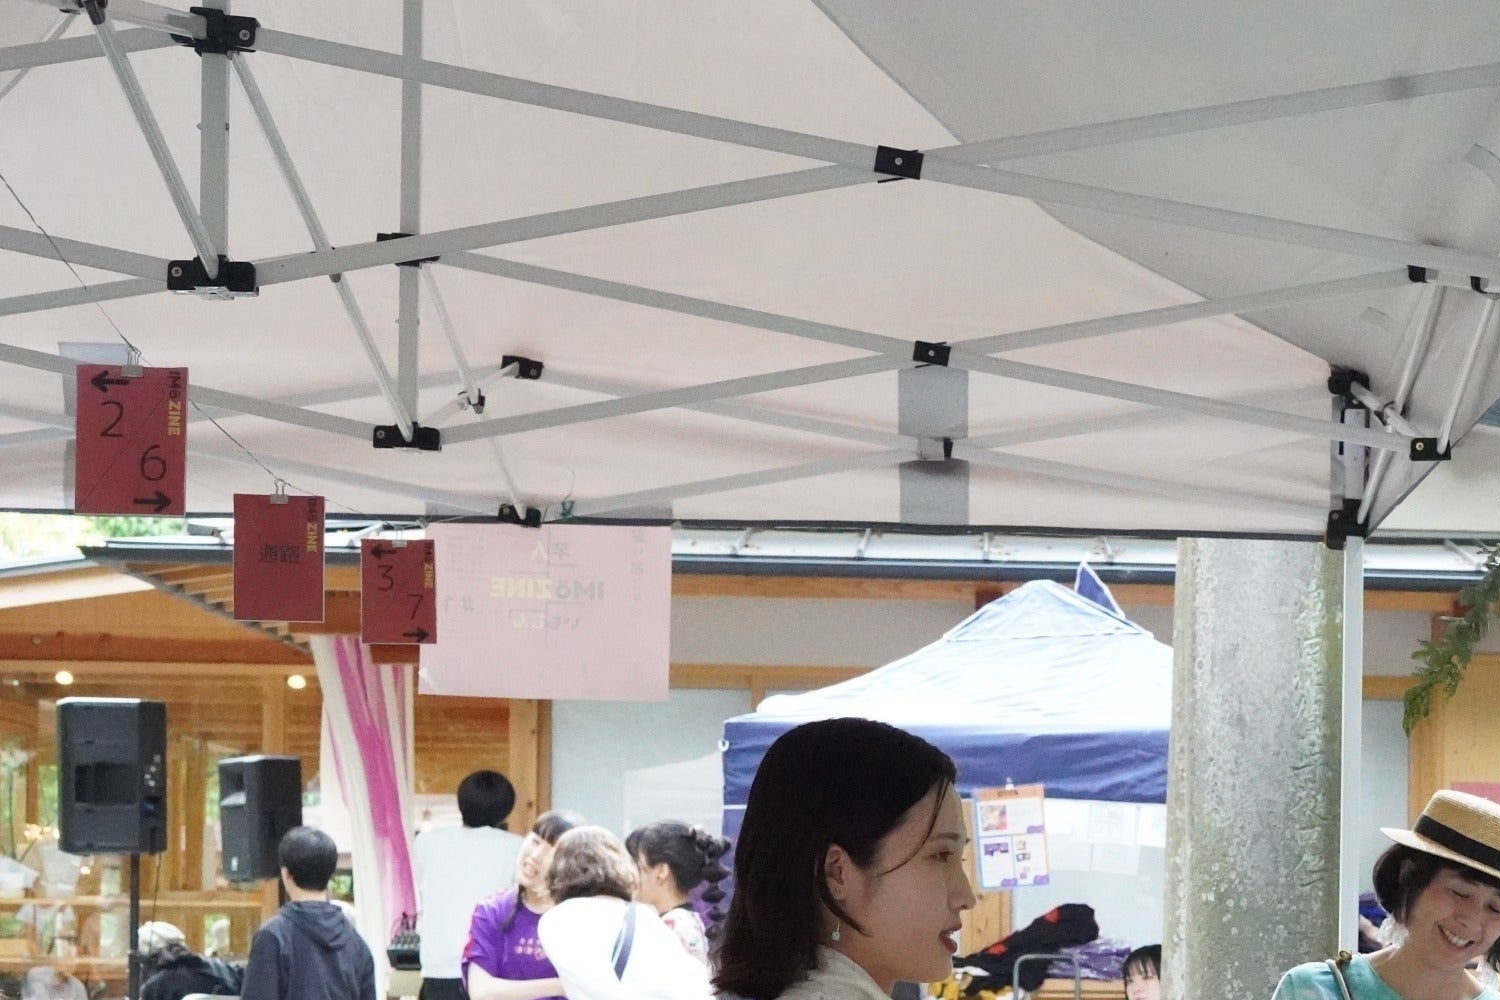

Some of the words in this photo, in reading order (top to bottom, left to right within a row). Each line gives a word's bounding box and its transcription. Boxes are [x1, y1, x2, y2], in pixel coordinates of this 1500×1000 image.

[100, 400, 124, 438] 2
[140, 444, 167, 482] 6
[377, 565, 395, 592] 3
[406, 594, 424, 620] 7
